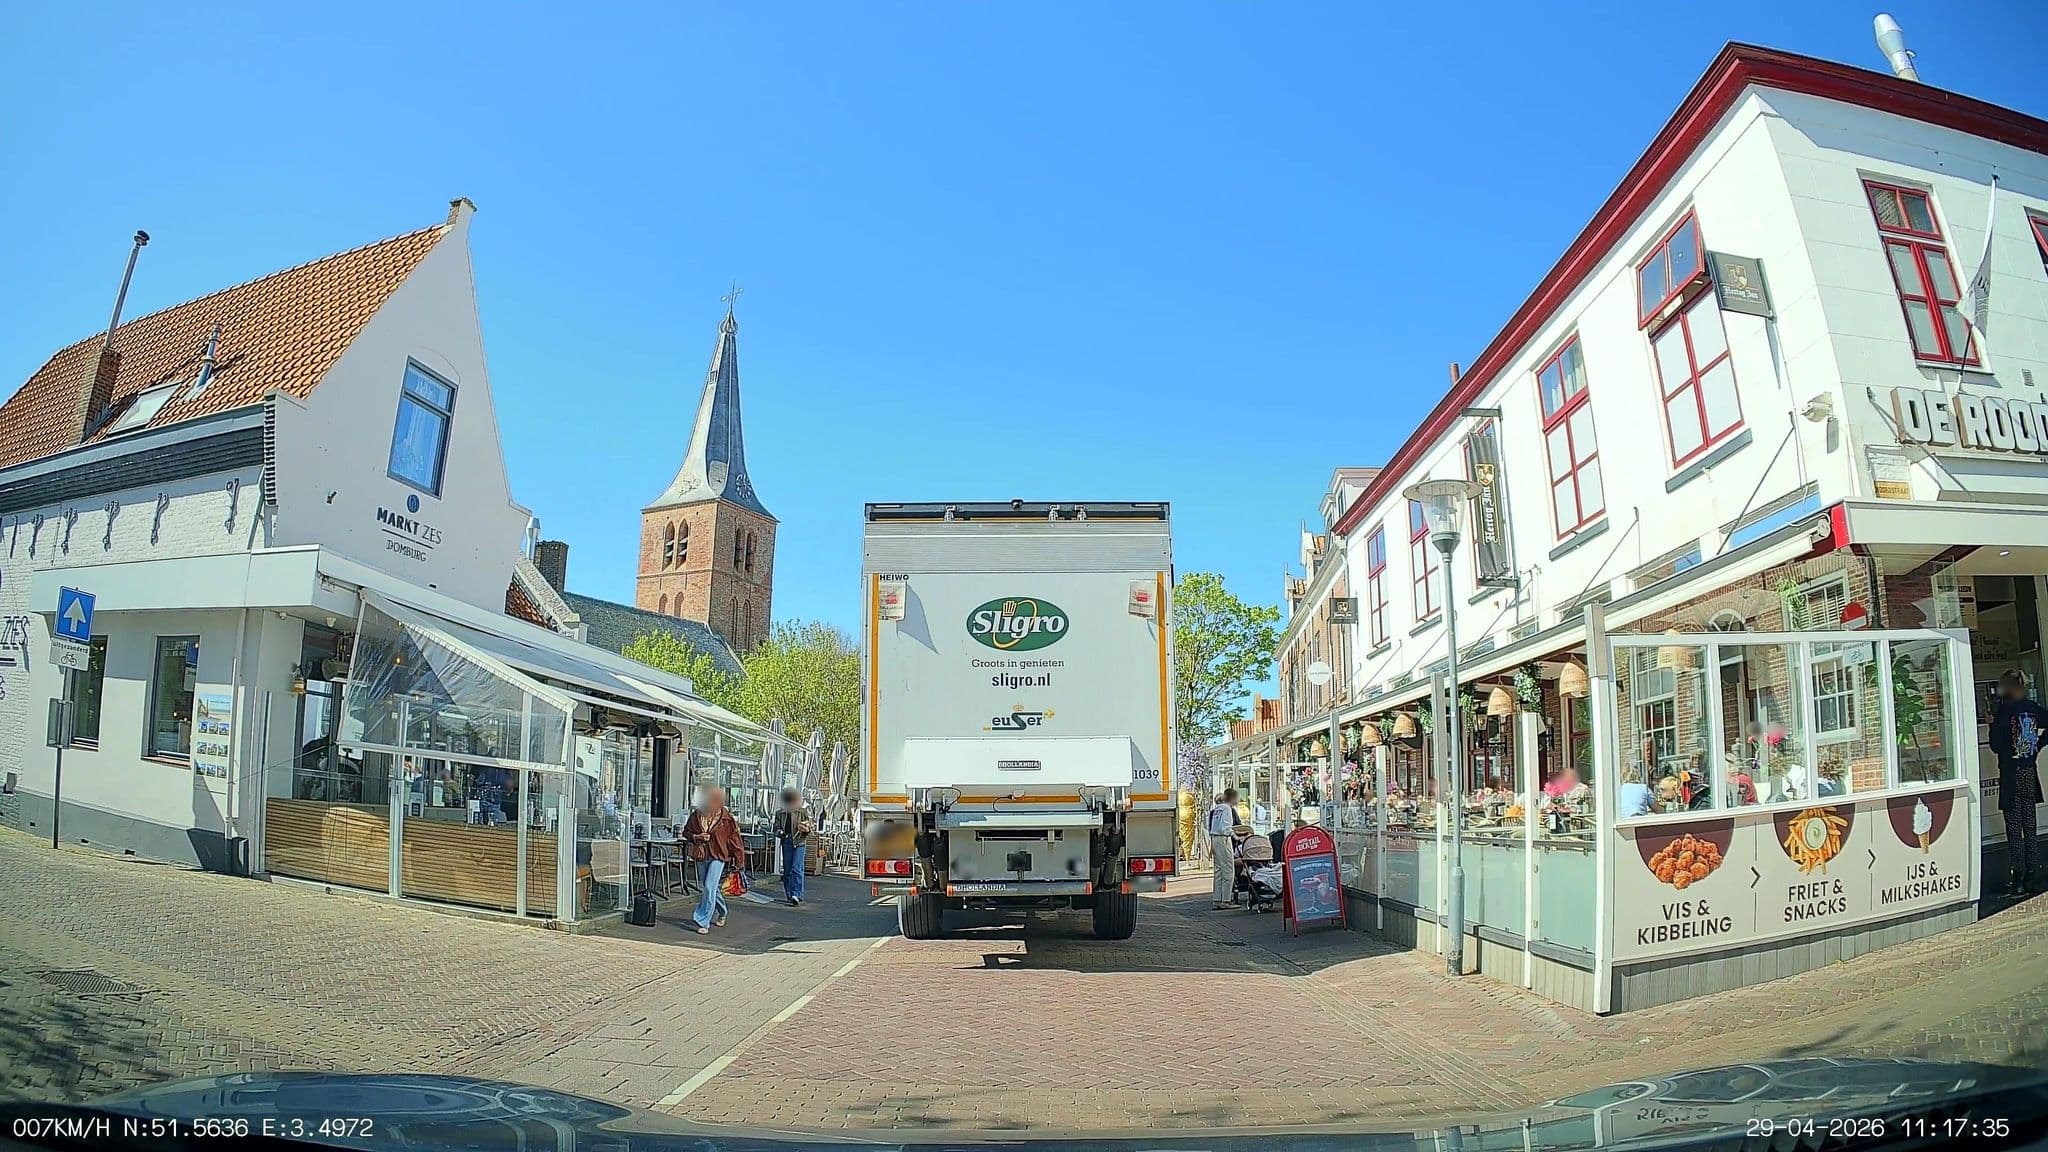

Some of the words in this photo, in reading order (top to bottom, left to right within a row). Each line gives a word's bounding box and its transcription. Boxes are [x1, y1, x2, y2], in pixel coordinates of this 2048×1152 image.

[1890, 386, 1955, 447] DE
[377, 507, 420, 535] MARKT
[422, 525, 442, 544] ZES
[386, 540, 427, 561] DOMBURG
[972, 609, 1066, 639] Sligro
[971, 659, 1005, 668] Groots
[1007, 658, 1018, 668] in
[1019, 658, 1065, 670] genieten
[991, 673, 1051, 689] sligro.nl
[1134, 769, 1160, 780] 1039
[1906, 863, 1926, 883] IJS
[1929, 860, 1939, 877] &
[1788, 880, 1829, 903] FRIET
[1832, 878, 1844, 895] &
[1881, 874, 1962, 905] MILKSHAKES
[1662, 901, 1691, 921] VIS
[1697, 898, 1710, 916] &
[1783, 897, 1847, 923] SNACKS
[1637, 916, 1733, 946] KIBBELING
